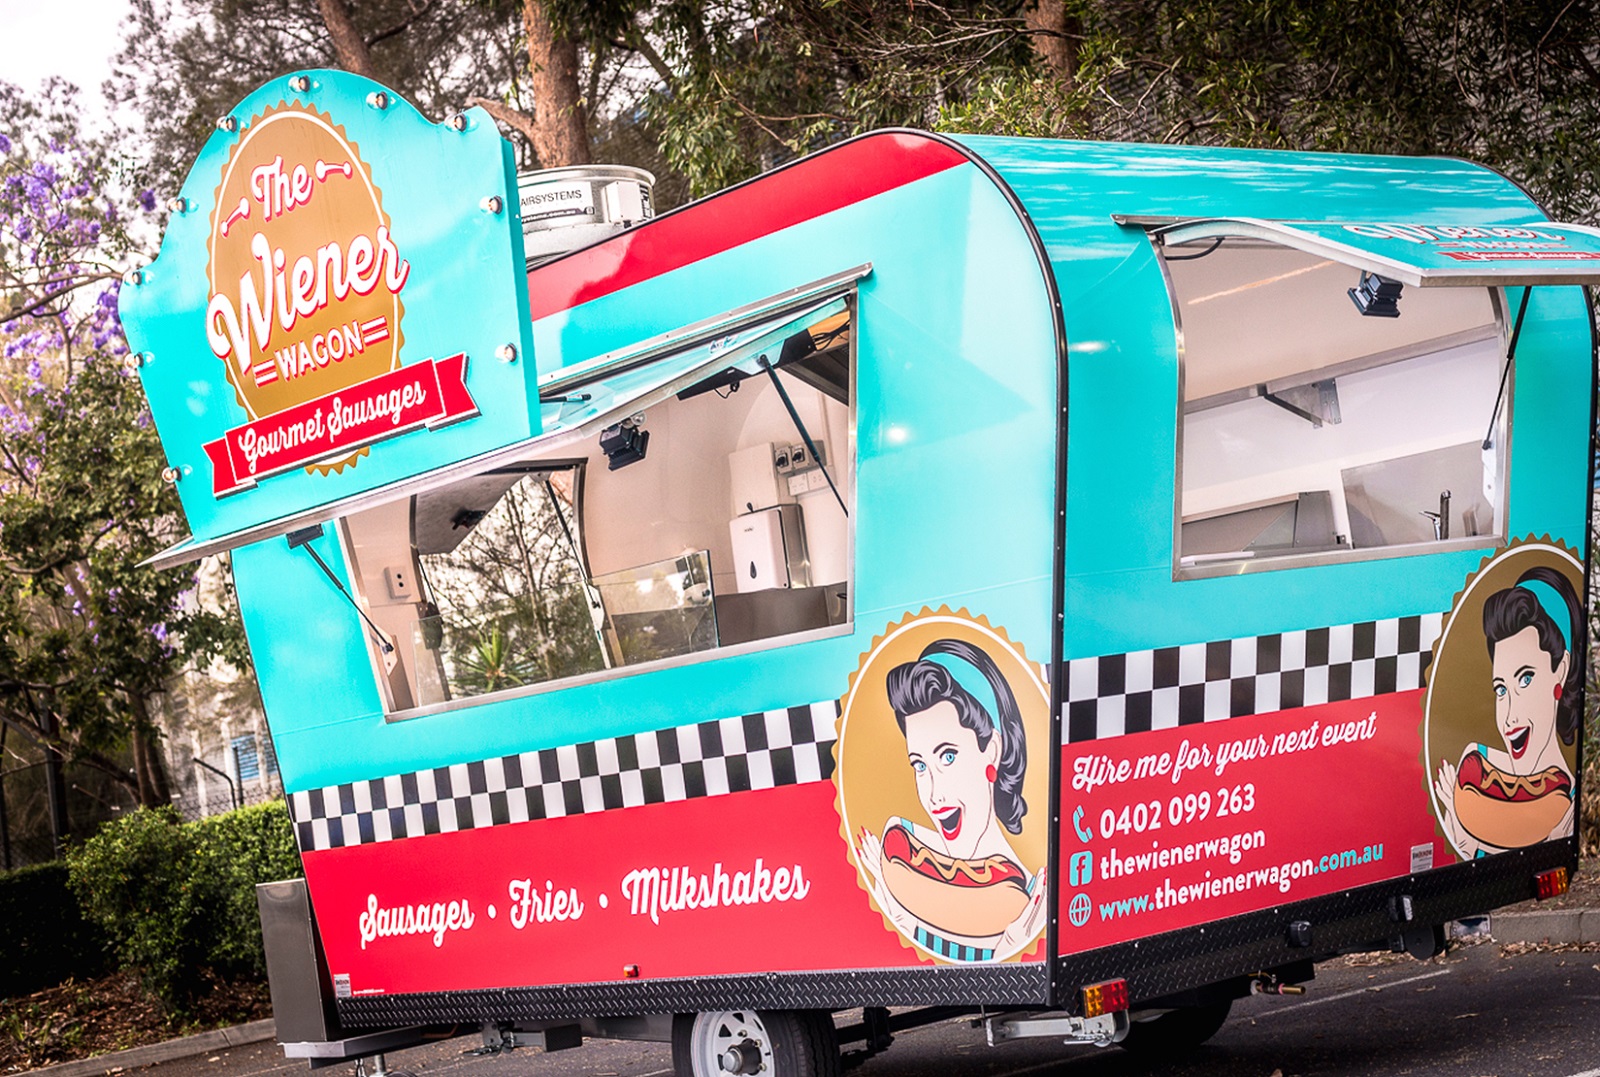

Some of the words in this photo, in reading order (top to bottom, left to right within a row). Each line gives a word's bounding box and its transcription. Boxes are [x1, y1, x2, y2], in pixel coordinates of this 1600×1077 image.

[251, 155, 313, 222] The
[520, 189, 582, 206] AIRSYSTEMS
[206, 225, 411, 376] Wiener
[275, 320, 365, 381] WAGON
[237, 408, 326, 473] Gourmet
[326, 380, 427, 443] Sausages
[1071, 753, 1132, 794] Hire
[1133, 752, 1172, 780] me
[1171, 739, 1214, 784] for
[1214, 733, 1270, 777] your
[1270, 720, 1320, 756] next
[1321, 711, 1377, 747] event
[1100, 800, 1162, 839] 0402
[1168, 791, 1211, 826] 099
[1216, 783, 1256, 818] 263
[1099, 843, 1384, 922] www.thewienerwagon.com.au
[1100, 829, 1266, 880] thewienerwagon
[359, 894, 475, 949] Sausages
[509, 878, 584, 929] Fries
[621, 858, 811, 925] Milkshakes
